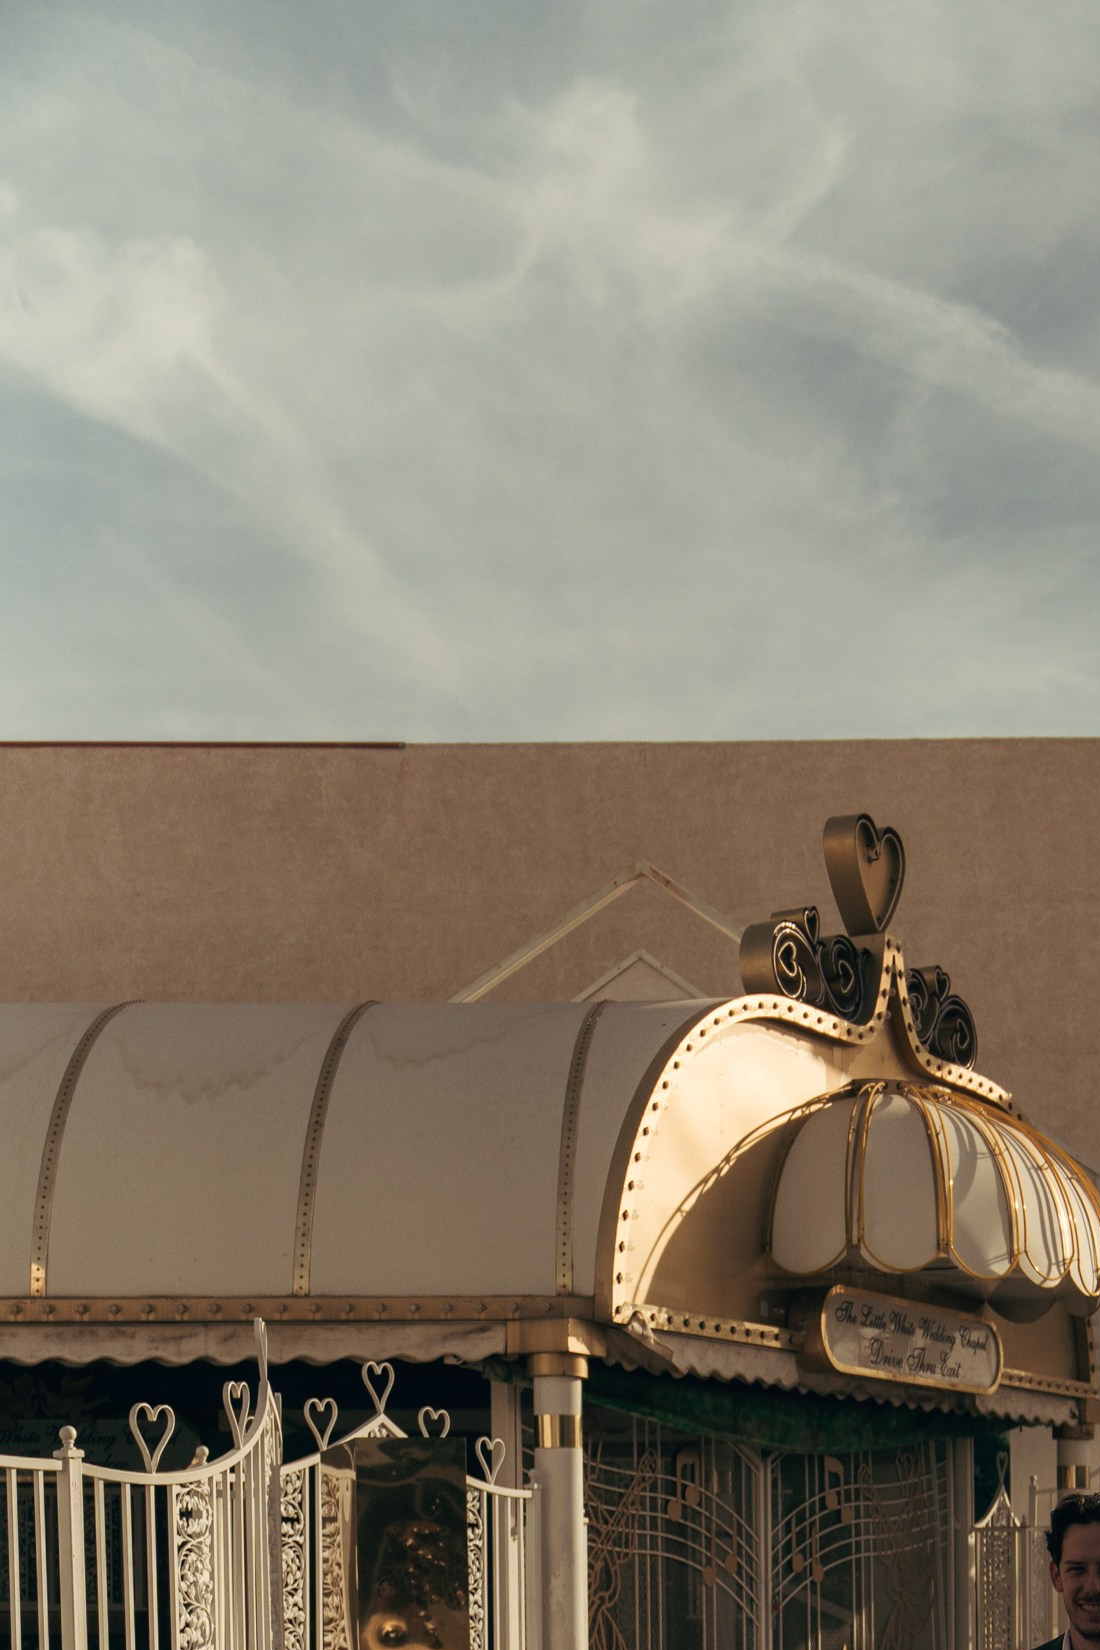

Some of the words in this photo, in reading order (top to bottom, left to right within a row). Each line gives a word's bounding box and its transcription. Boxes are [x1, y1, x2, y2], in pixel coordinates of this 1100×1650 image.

[834, 1300, 857, 1324] The
[860, 1304, 887, 1331] Little
[889, 1310, 916, 1337] White
[918, 1317, 957, 1351] Wedding
[959, 1325, 989, 1356] Chapel
[869, 1337, 904, 1370] Drive
[906, 1347, 937, 1375] Thru
[940, 1351, 962, 1379] Exit
